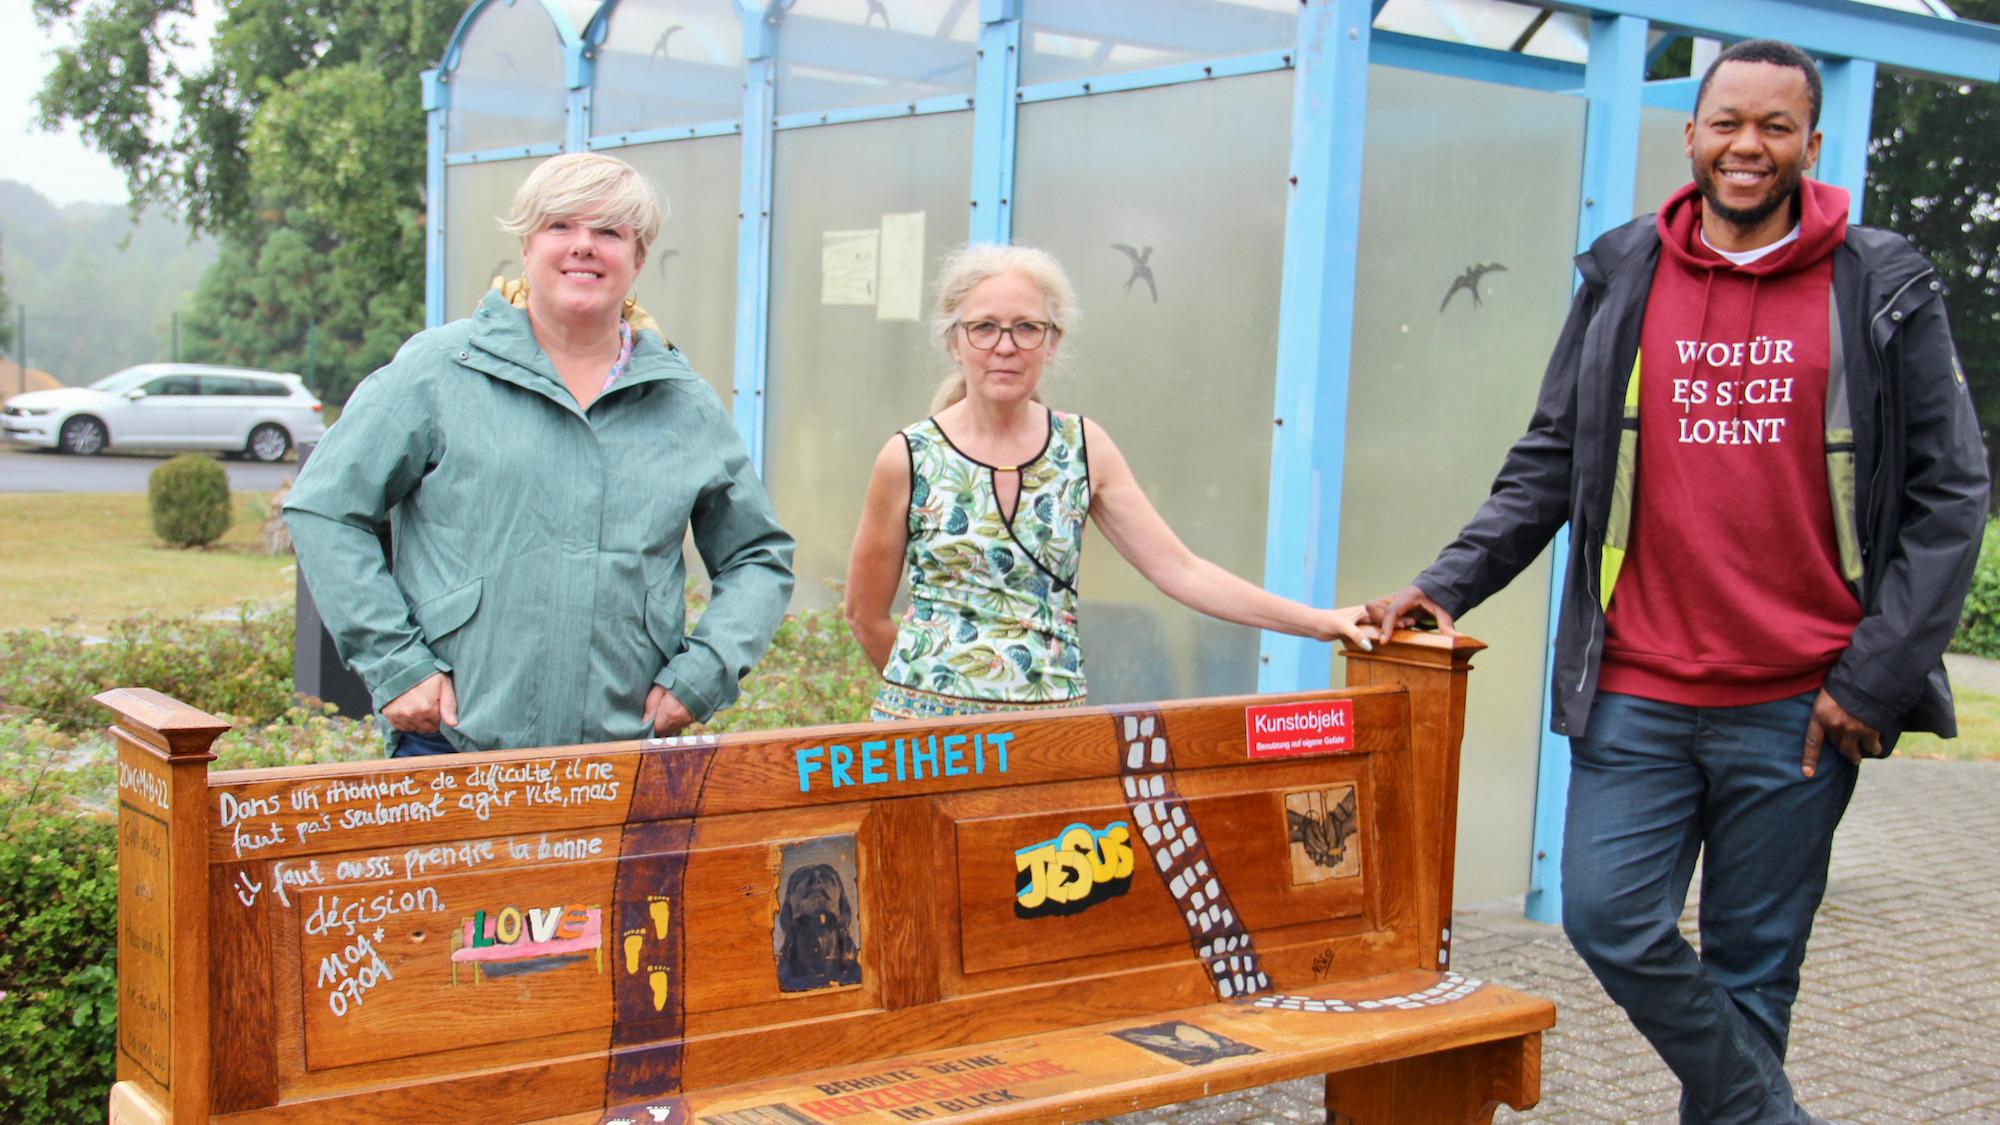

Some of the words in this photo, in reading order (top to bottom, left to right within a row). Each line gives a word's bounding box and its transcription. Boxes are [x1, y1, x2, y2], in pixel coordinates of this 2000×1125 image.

[1675, 336, 1794, 367] WOFÜR
[1672, 379, 1708, 404] ES
[1715, 378, 1794, 406] SCH
[1678, 418, 1786, 444] LOHNT
[1255, 709, 1345, 733] Kunstobjekt
[1256, 741, 1291, 751] Benutzung
[1291, 739, 1302, 748] auf
[1302, 738, 1323, 748] eigene
[1324, 736, 1345, 745] Gefahr
[430, 771, 457, 791] de
[565, 758, 581, 779] il
[586, 762, 613, 780] ne
[795, 732, 1014, 792] FREIHEIT
[273, 860, 325, 907] faut
[336, 856, 394, 880] aussi
[405, 839, 494, 880] prendre
[509, 836, 531, 860] la
[537, 833, 603, 860] bonne
[1015, 823, 1134, 910] JESUS
[472, 904, 589, 948] LOVE
[814, 1069, 922, 1096] BEHALTE
[928, 1054, 1008, 1074] DEINE
[890, 1105, 935, 1121] IM
[935, 1089, 1025, 1113] BLICK
